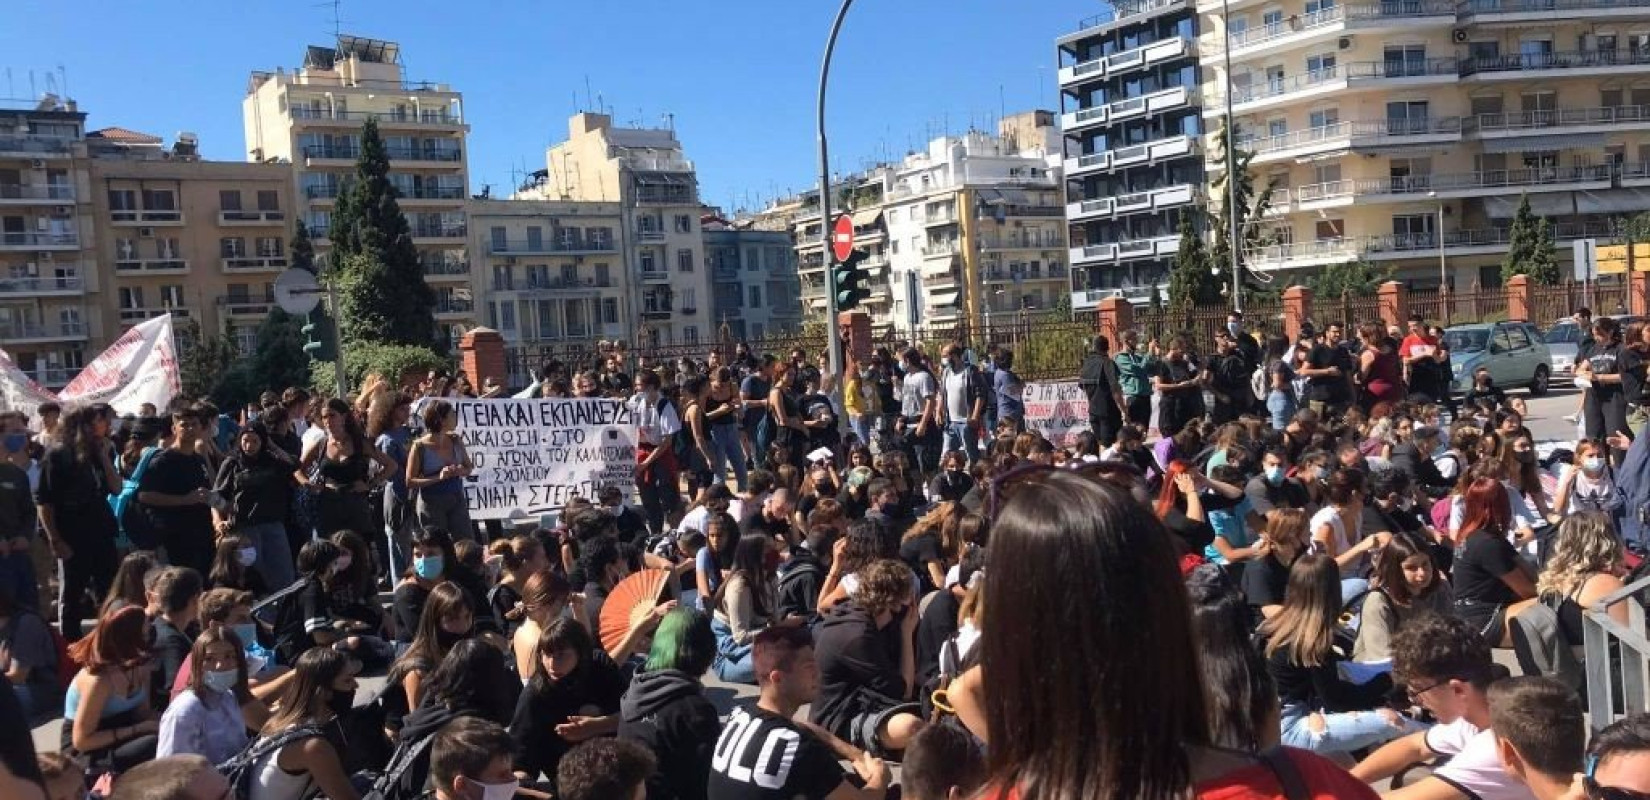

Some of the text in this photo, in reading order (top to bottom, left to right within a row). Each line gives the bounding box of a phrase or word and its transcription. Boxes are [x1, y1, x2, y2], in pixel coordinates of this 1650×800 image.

[504, 402, 535, 427] ΚΑΙ
[552, 428, 586, 447] ΣΤΟ
[498, 449, 542, 467] ΑΓΩΝΑ
[546, 447, 570, 463] ΤΟΥ
[464, 485, 518, 510] ΕΝΙΑΙΑ
[712, 705, 800, 790] OLO
